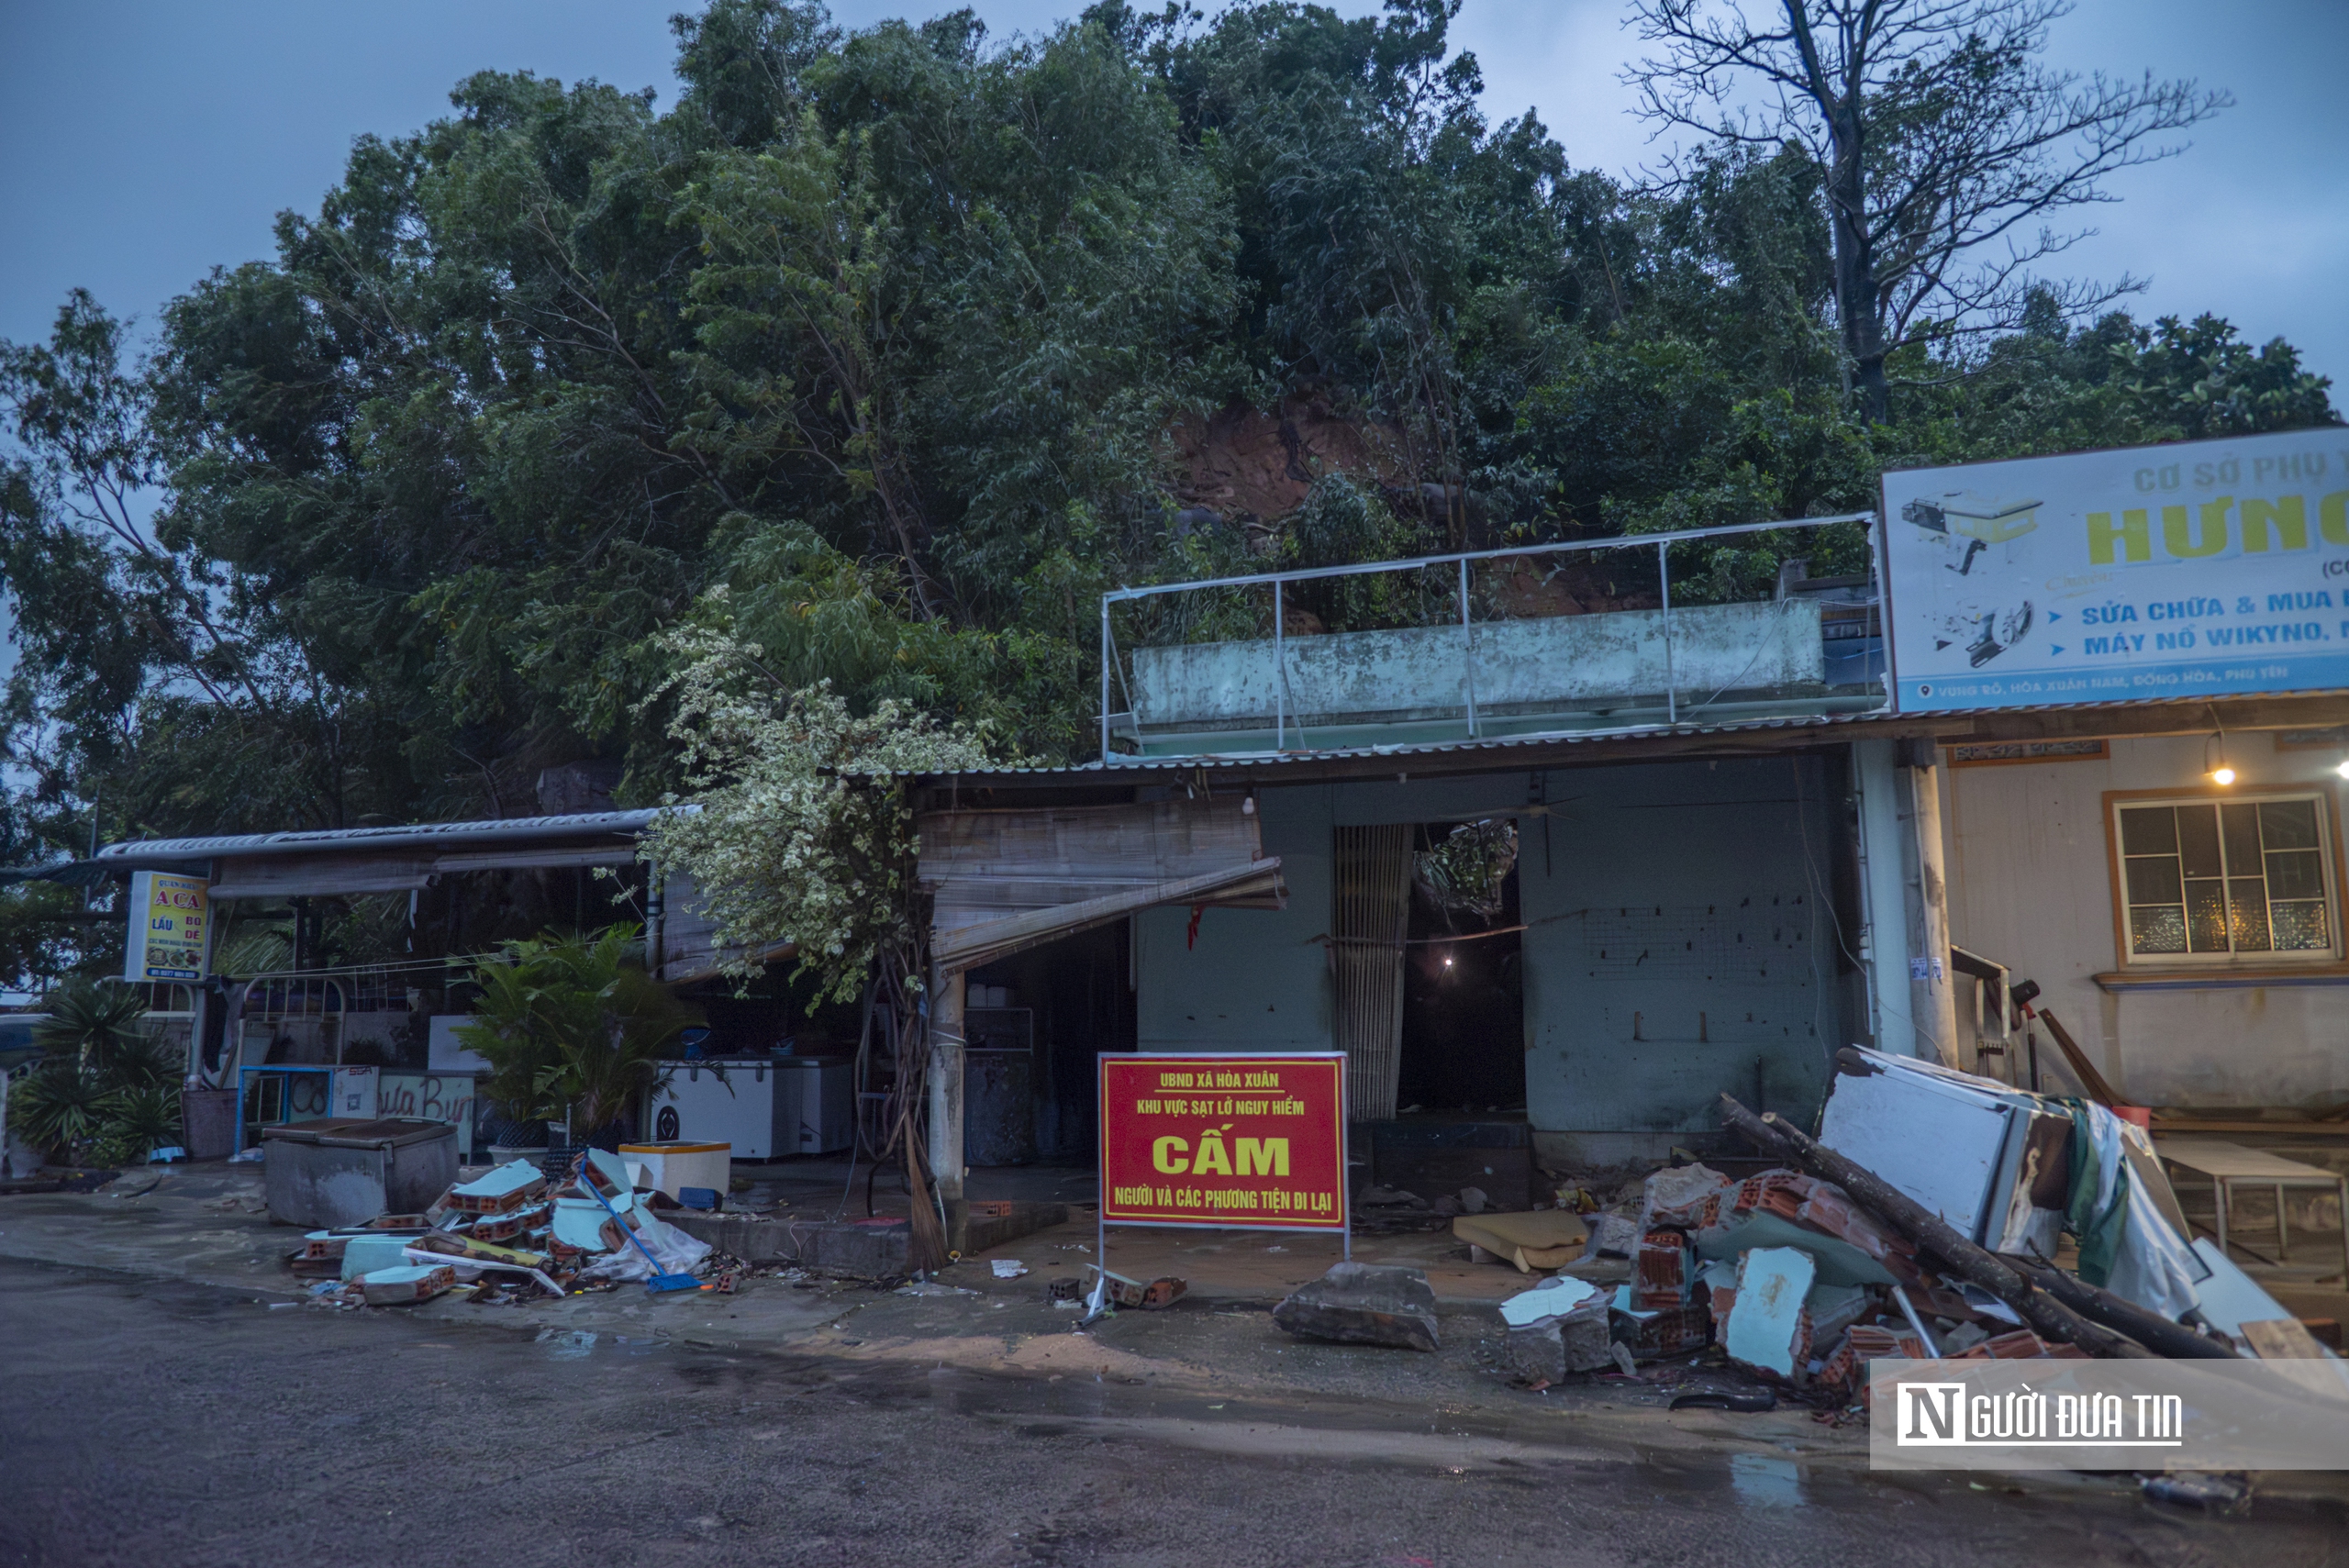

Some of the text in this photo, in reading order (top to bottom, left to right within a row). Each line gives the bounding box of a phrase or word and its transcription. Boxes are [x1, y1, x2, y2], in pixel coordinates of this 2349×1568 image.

[2081, 600, 2138, 625] SỬA
[2147, 596, 2225, 620] CHỮA
[2236, 596, 2255, 614] &
[2267, 590, 2332, 612] MUA
[2084, 631, 2145, 655] MÁY
[1160, 1070, 1279, 1087] UBND XÃ HÒA XUÂN
[1137, 1095, 1304, 1118] KHU VỰC SẠT LỞ NGUY HIỂM
[1152, 1123, 1290, 1176] CẤM
[1115, 1183, 1331, 1216] NGƯỜI VÀ CÁC PHƯƠNG TIỆN ĐI LẠI
